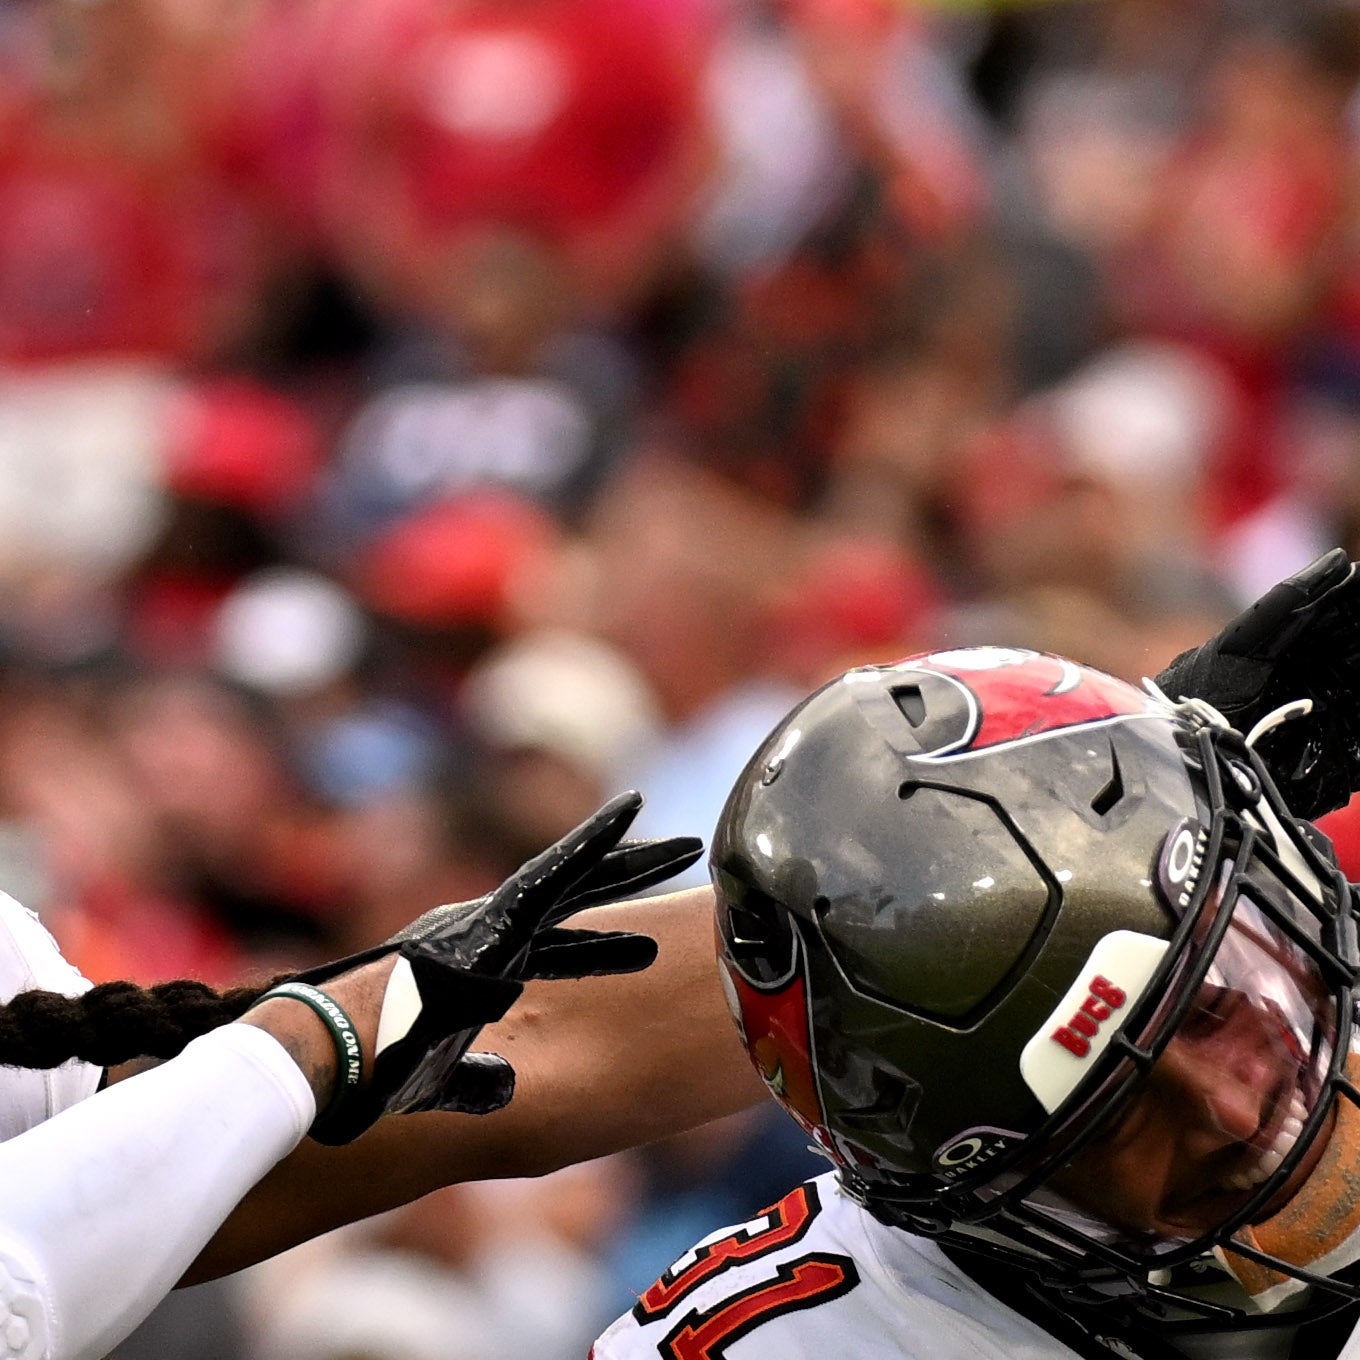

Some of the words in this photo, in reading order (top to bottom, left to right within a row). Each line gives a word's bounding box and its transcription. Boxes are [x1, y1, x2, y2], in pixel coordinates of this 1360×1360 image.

[1178, 829, 1208, 907] OAKLEY
[342, 1030, 360, 1057] ON
[1049, 973, 1127, 1058] BUCS
[944, 1138, 1007, 1178] OAKLEY
